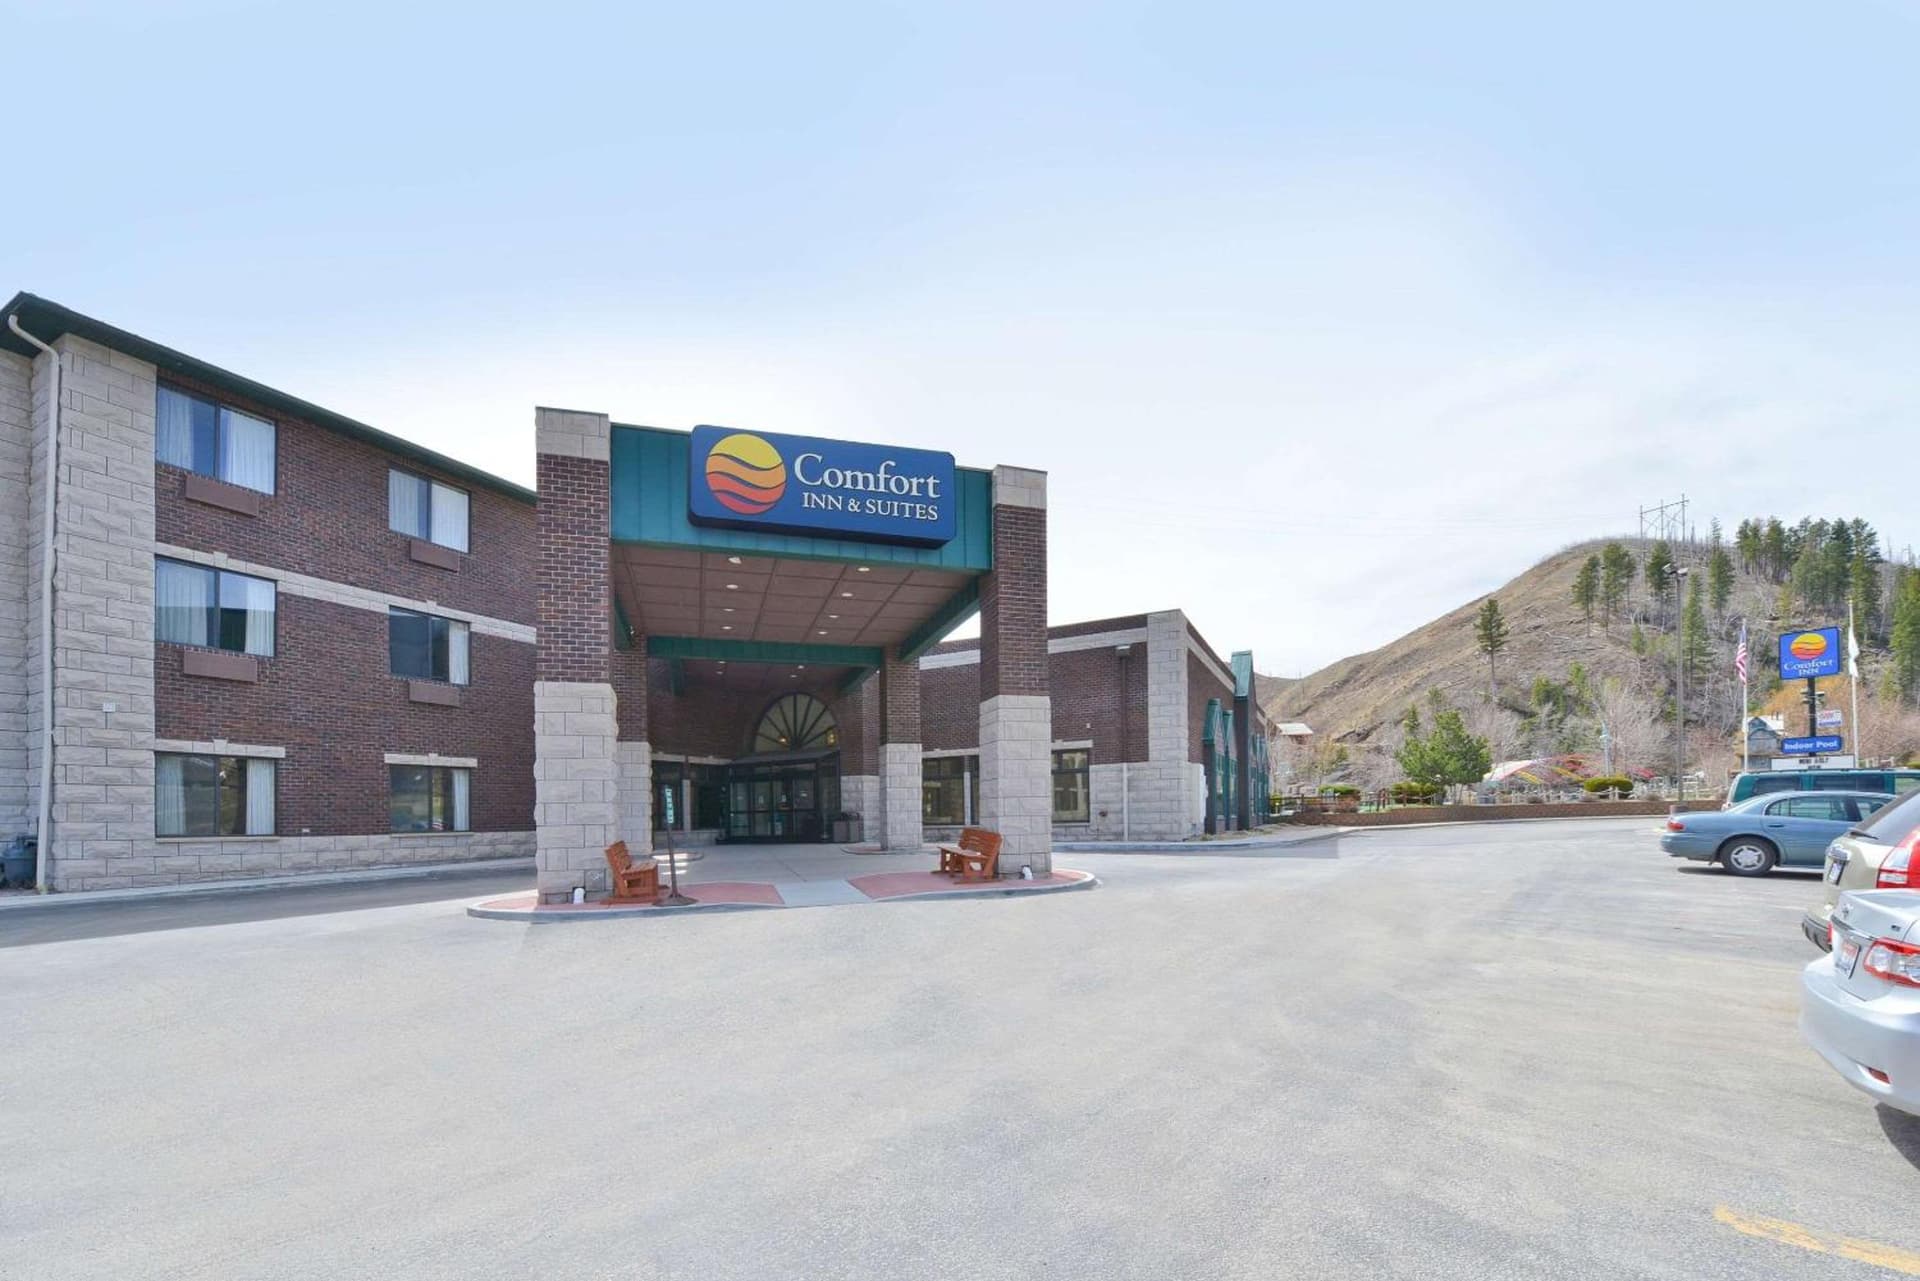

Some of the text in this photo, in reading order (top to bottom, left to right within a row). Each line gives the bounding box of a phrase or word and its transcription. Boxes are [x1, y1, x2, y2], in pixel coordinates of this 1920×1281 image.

[794, 453, 941, 498] Comfort
[802, 492, 938, 520] INN & SUITES
[1784, 659, 1833, 670] Comfort
[1784, 740, 1838, 750] Indoor Pool
